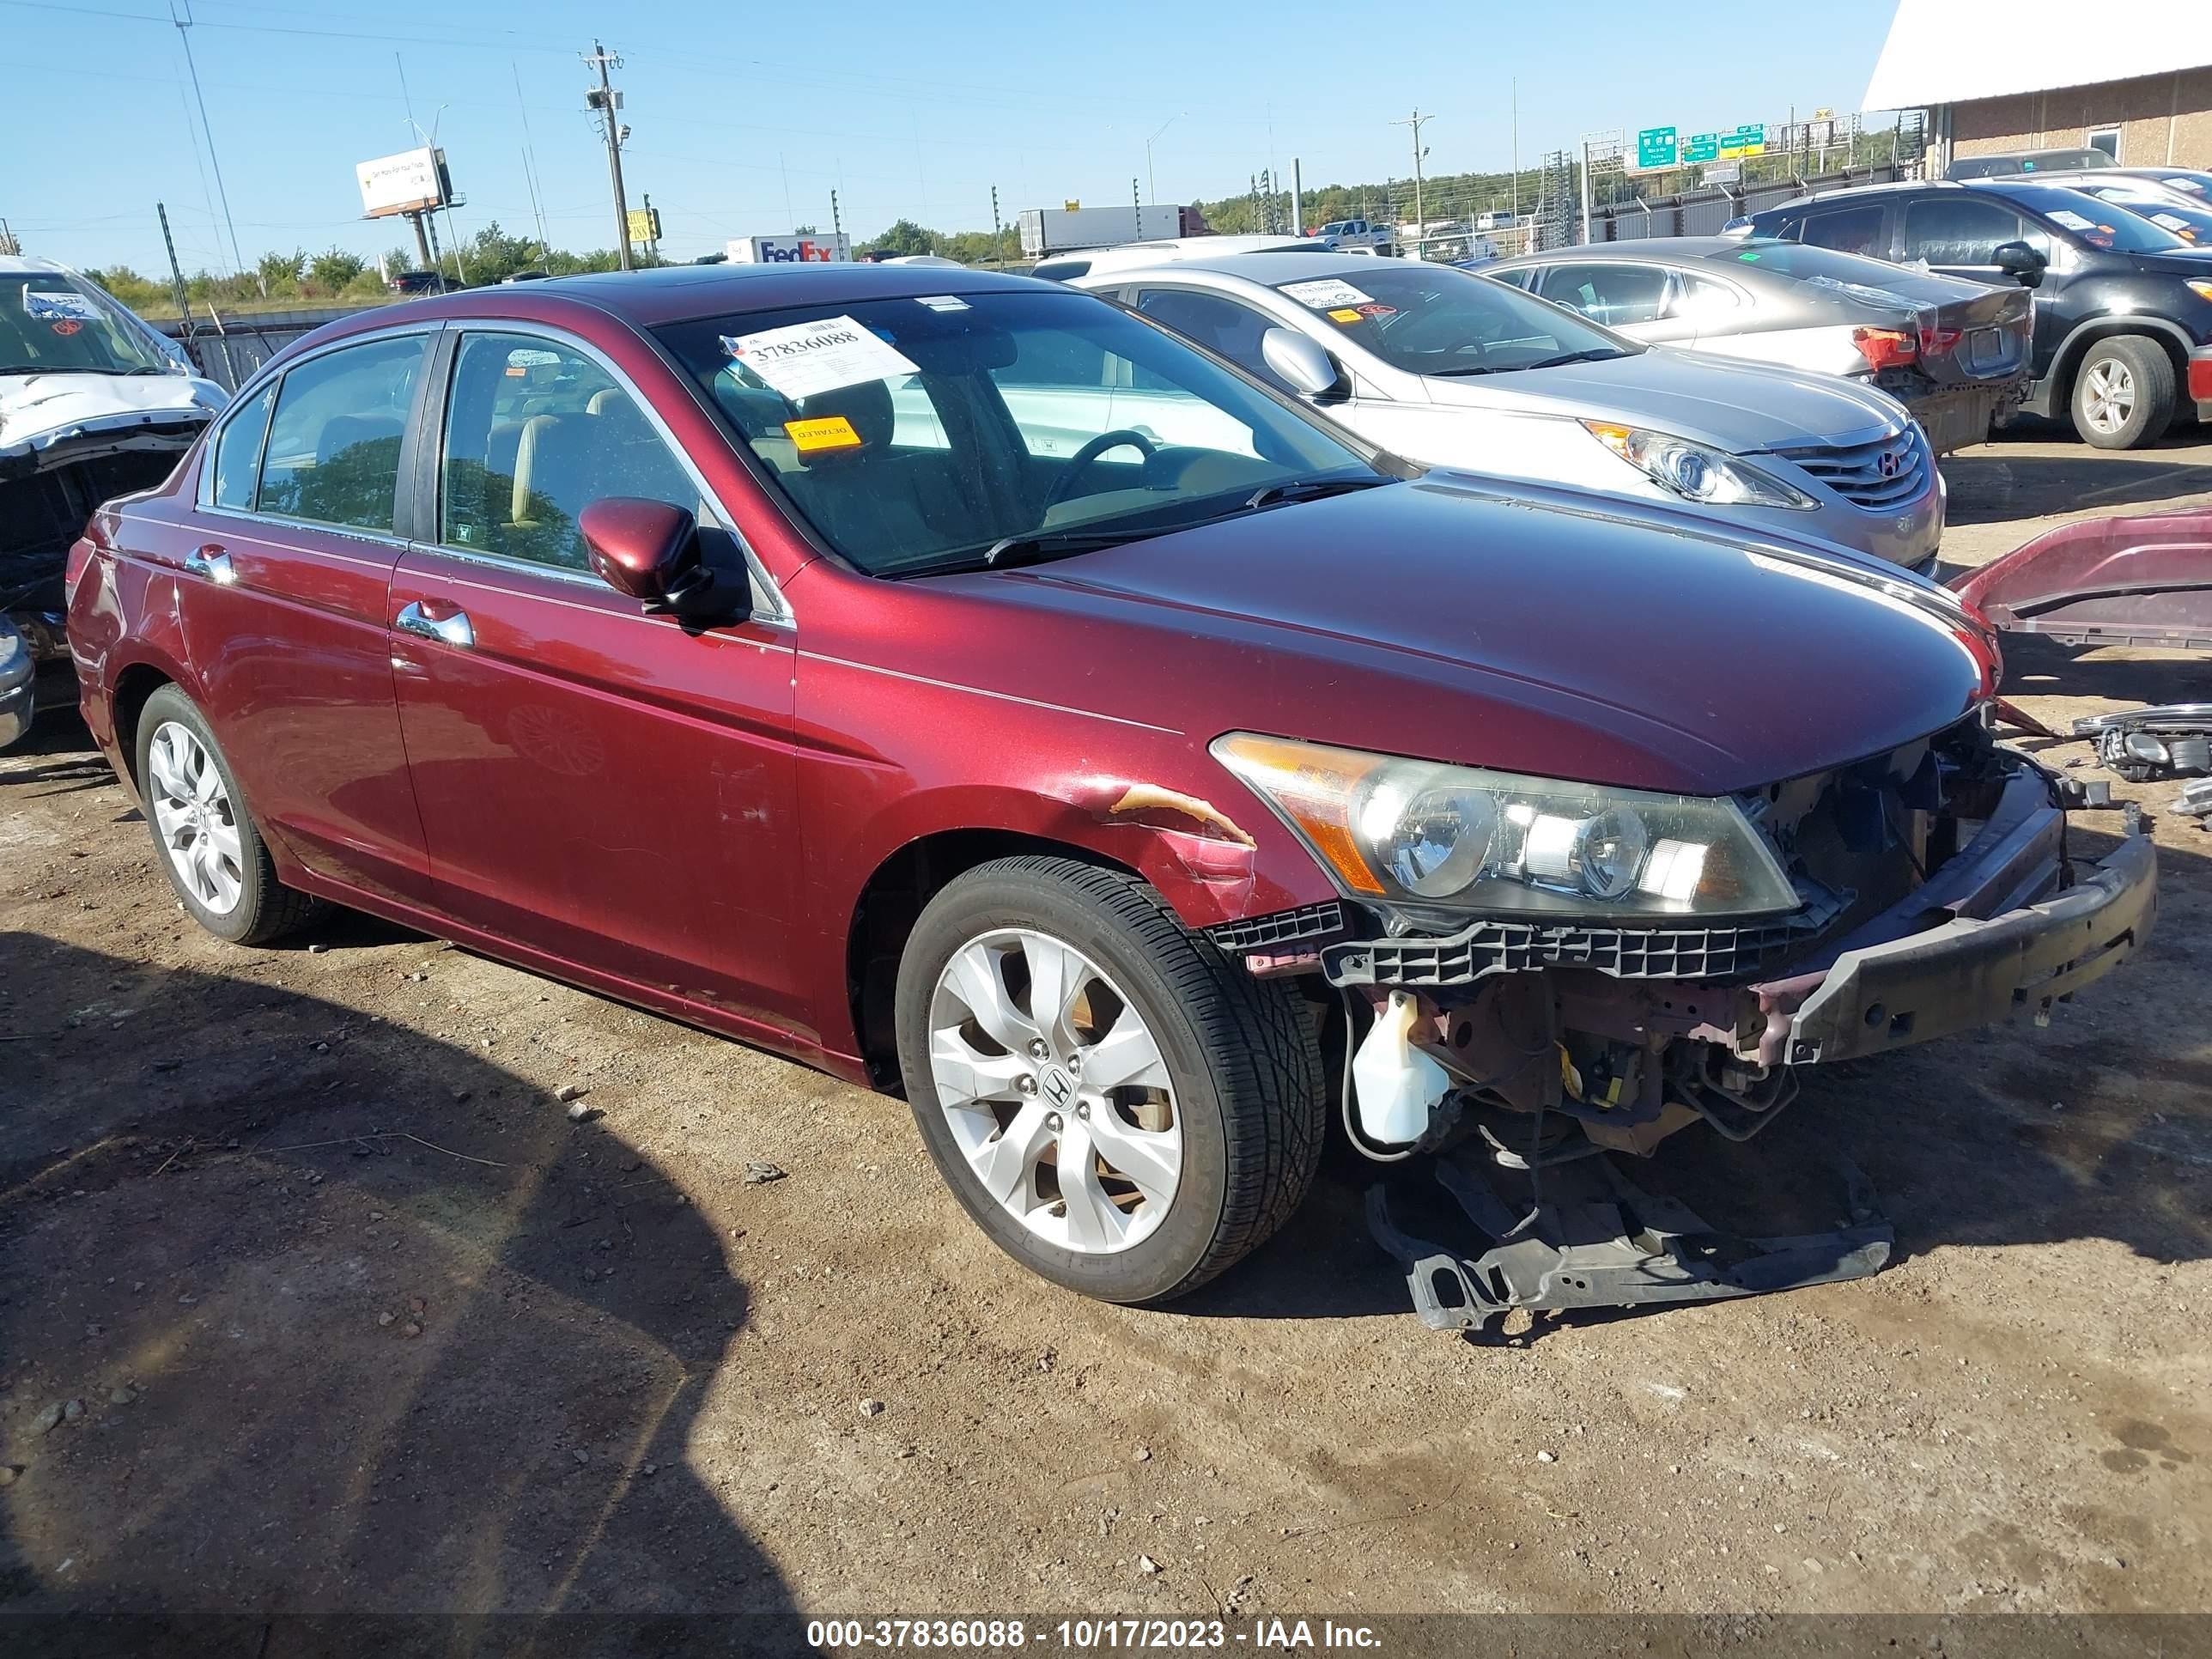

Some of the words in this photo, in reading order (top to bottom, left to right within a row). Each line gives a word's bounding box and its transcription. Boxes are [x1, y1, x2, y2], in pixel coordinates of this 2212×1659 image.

[634, 225, 647, 240] INN
[760, 241, 832, 263] FedEx
[750, 331, 859, 362] 37836088
[798, 428, 848, 438] DETAILED
